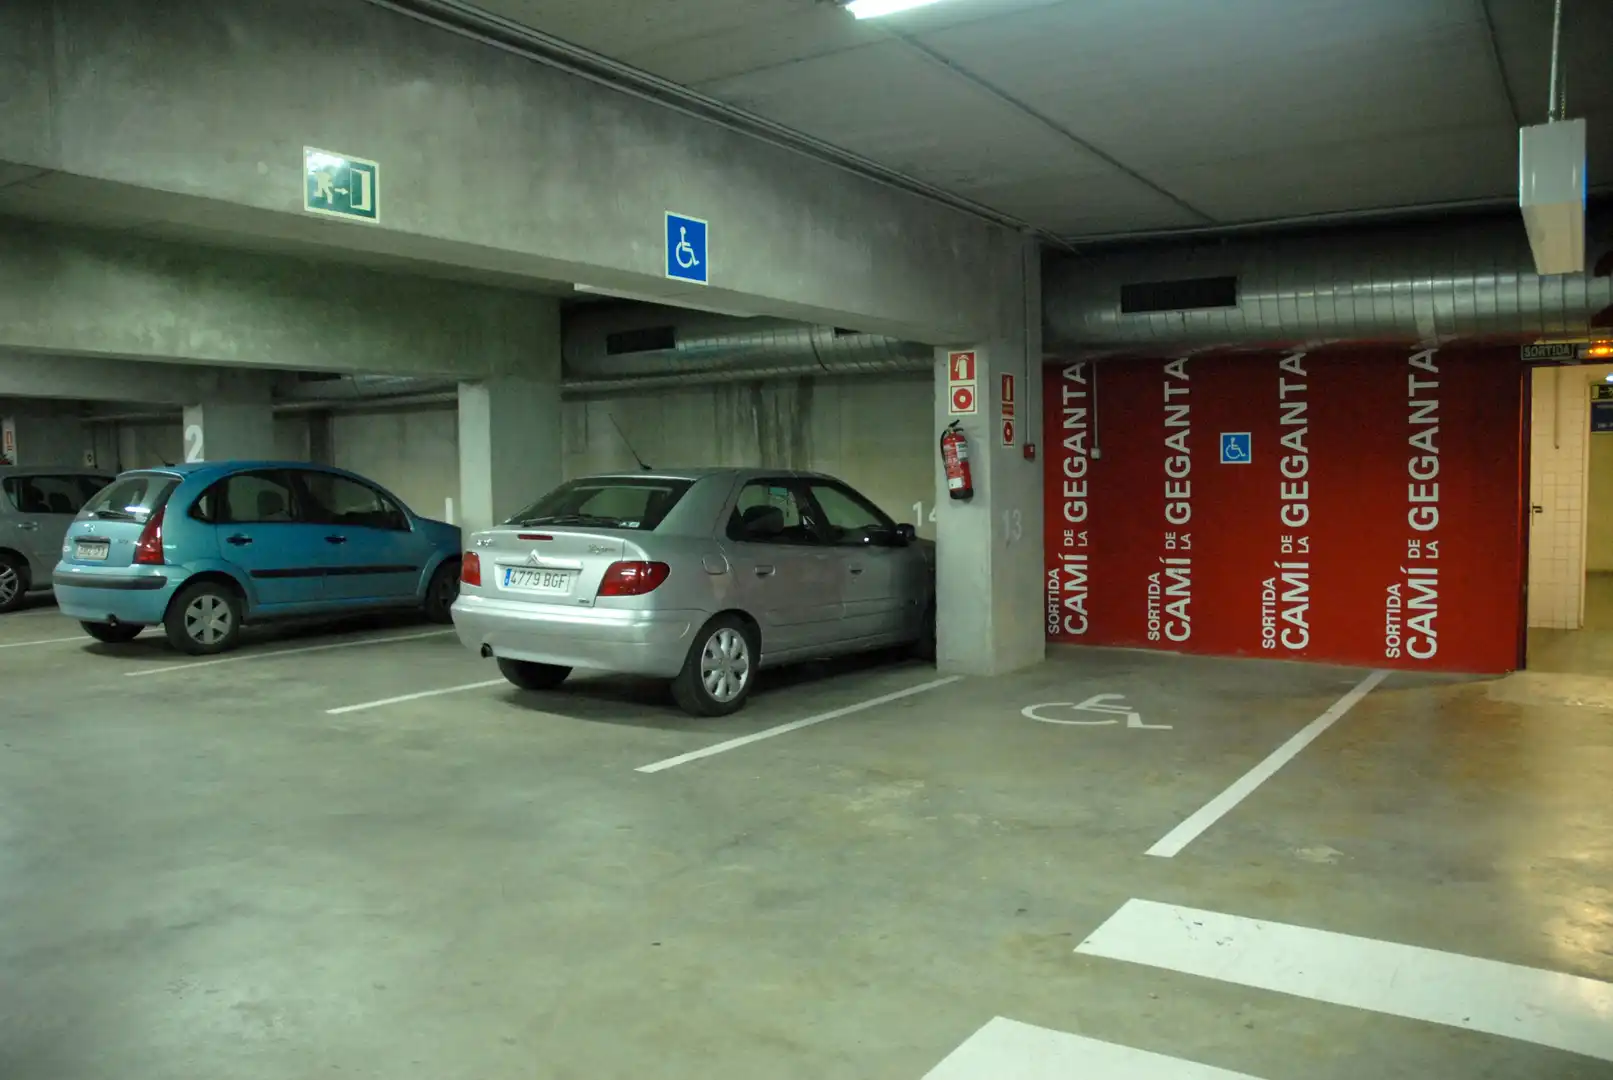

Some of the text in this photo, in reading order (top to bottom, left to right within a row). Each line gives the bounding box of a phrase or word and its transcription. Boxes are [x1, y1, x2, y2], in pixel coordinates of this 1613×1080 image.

[1524, 345, 1570, 357] SORTIDA
[185, 425, 204, 463] 2
[1058, 362, 1088, 635] CAMÍ DE GEGANTA
[1159, 357, 1191, 642] CAMÍ DE GEGANTA
[1274, 351, 1309, 650] CAMÍ DE GEGANTA
[1400, 348, 1439, 660] CAMÍ DE GEGANTA
[1078, 530, 1088, 547] LA
[1180, 533, 1191, 550] LA
[1298, 536, 1309, 554] LA
[1426, 540, 1439, 559] LA
[511, 570, 567, 588] 4779 BGF
[1048, 567, 1060, 635] SORTIDA
[1148, 572, 1160, 641] SORTIDA
[1262, 577, 1276, 649] SORTIDA
[1385, 583, 1401, 658] SORTIDA
